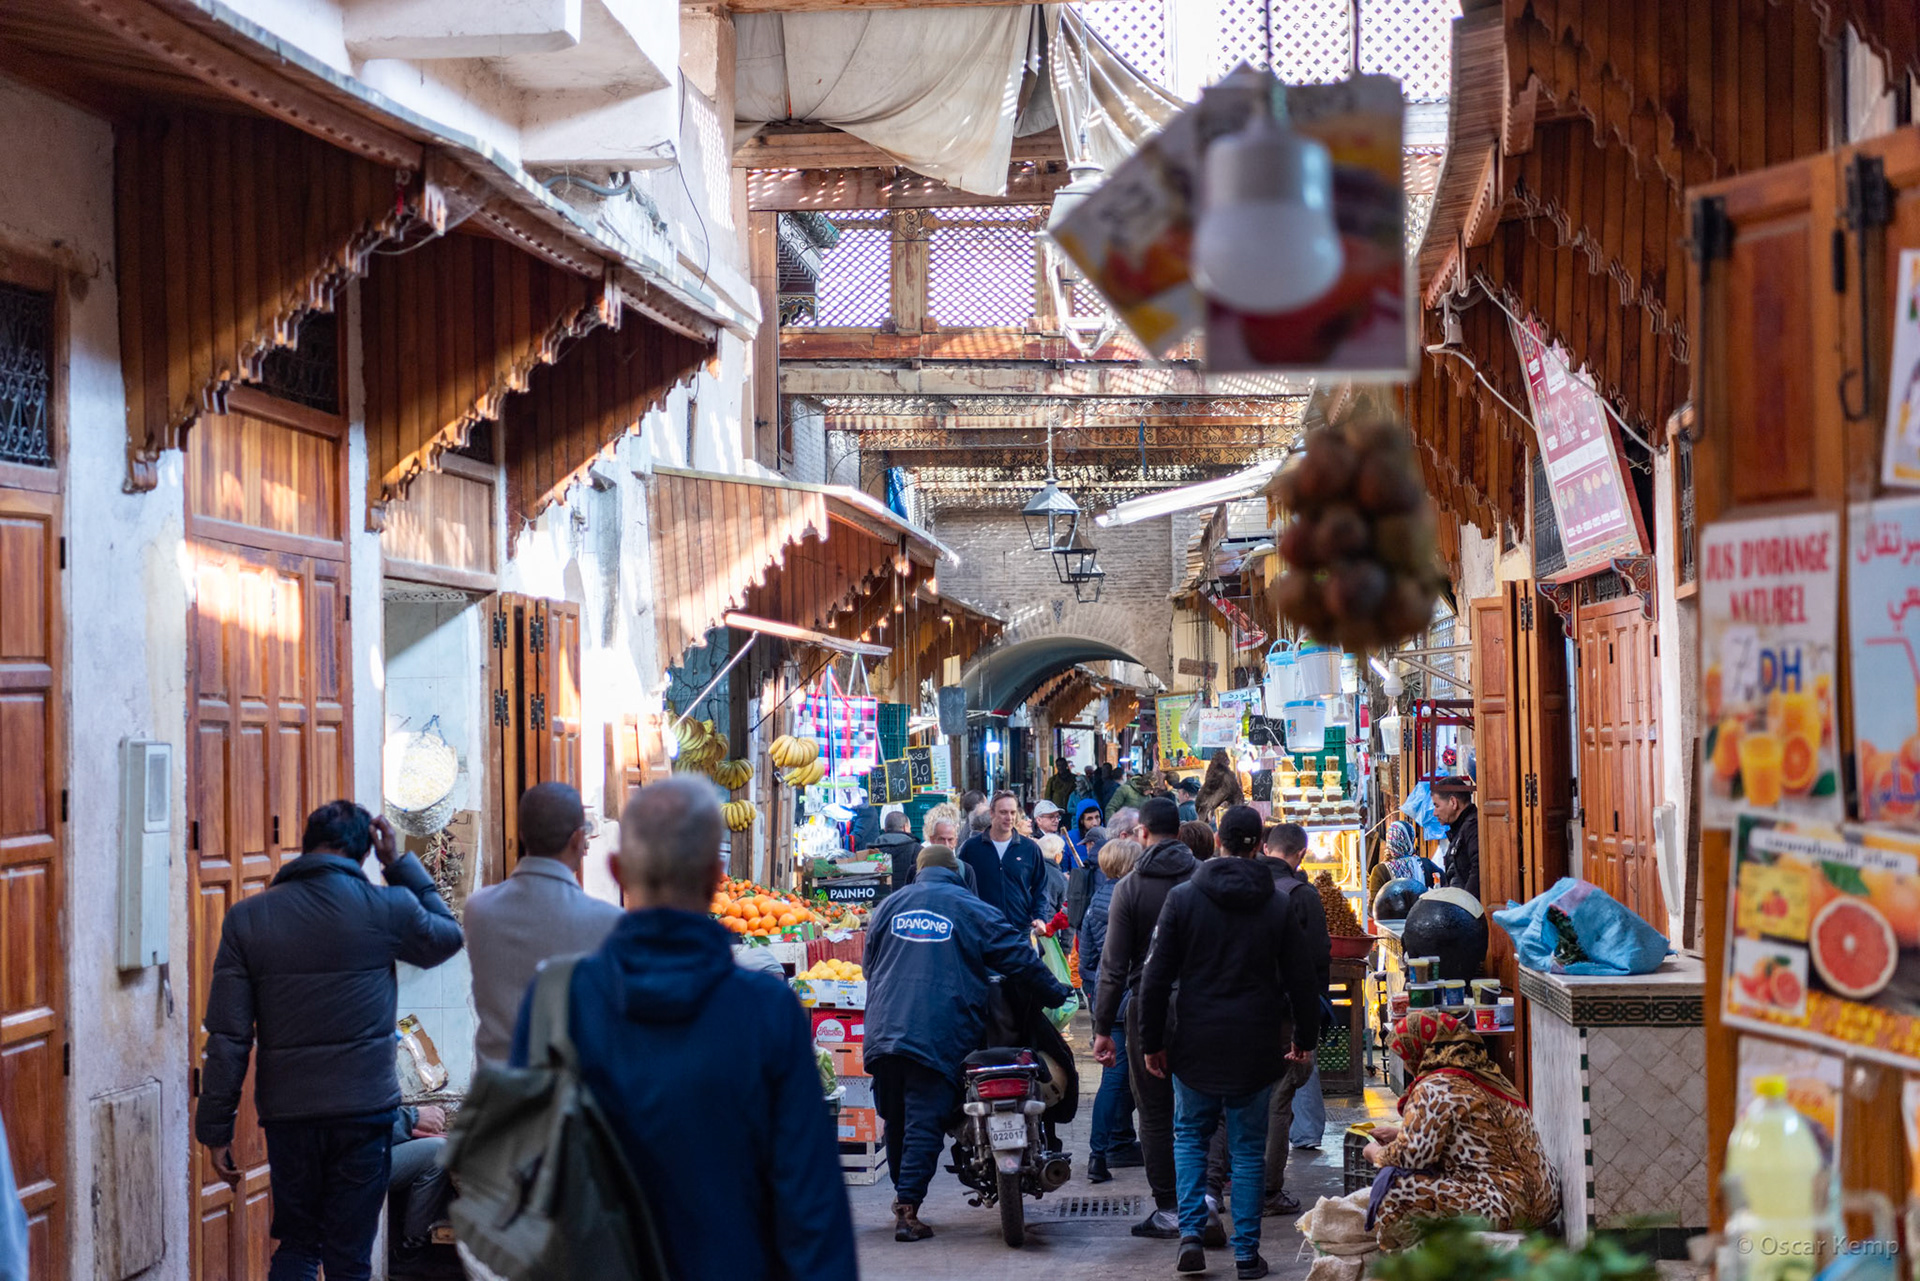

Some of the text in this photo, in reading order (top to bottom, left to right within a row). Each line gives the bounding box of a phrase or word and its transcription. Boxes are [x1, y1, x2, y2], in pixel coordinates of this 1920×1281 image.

[1706, 532, 1829, 581] JUS D'ORANGE
[1729, 585, 1807, 625] NATUREL
[1758, 648, 1803, 694] DH
[830, 887, 876, 899] PAINHO
[993, 1131, 1024, 1142] 022017
[1003, 1121, 1013, 1129] 15
